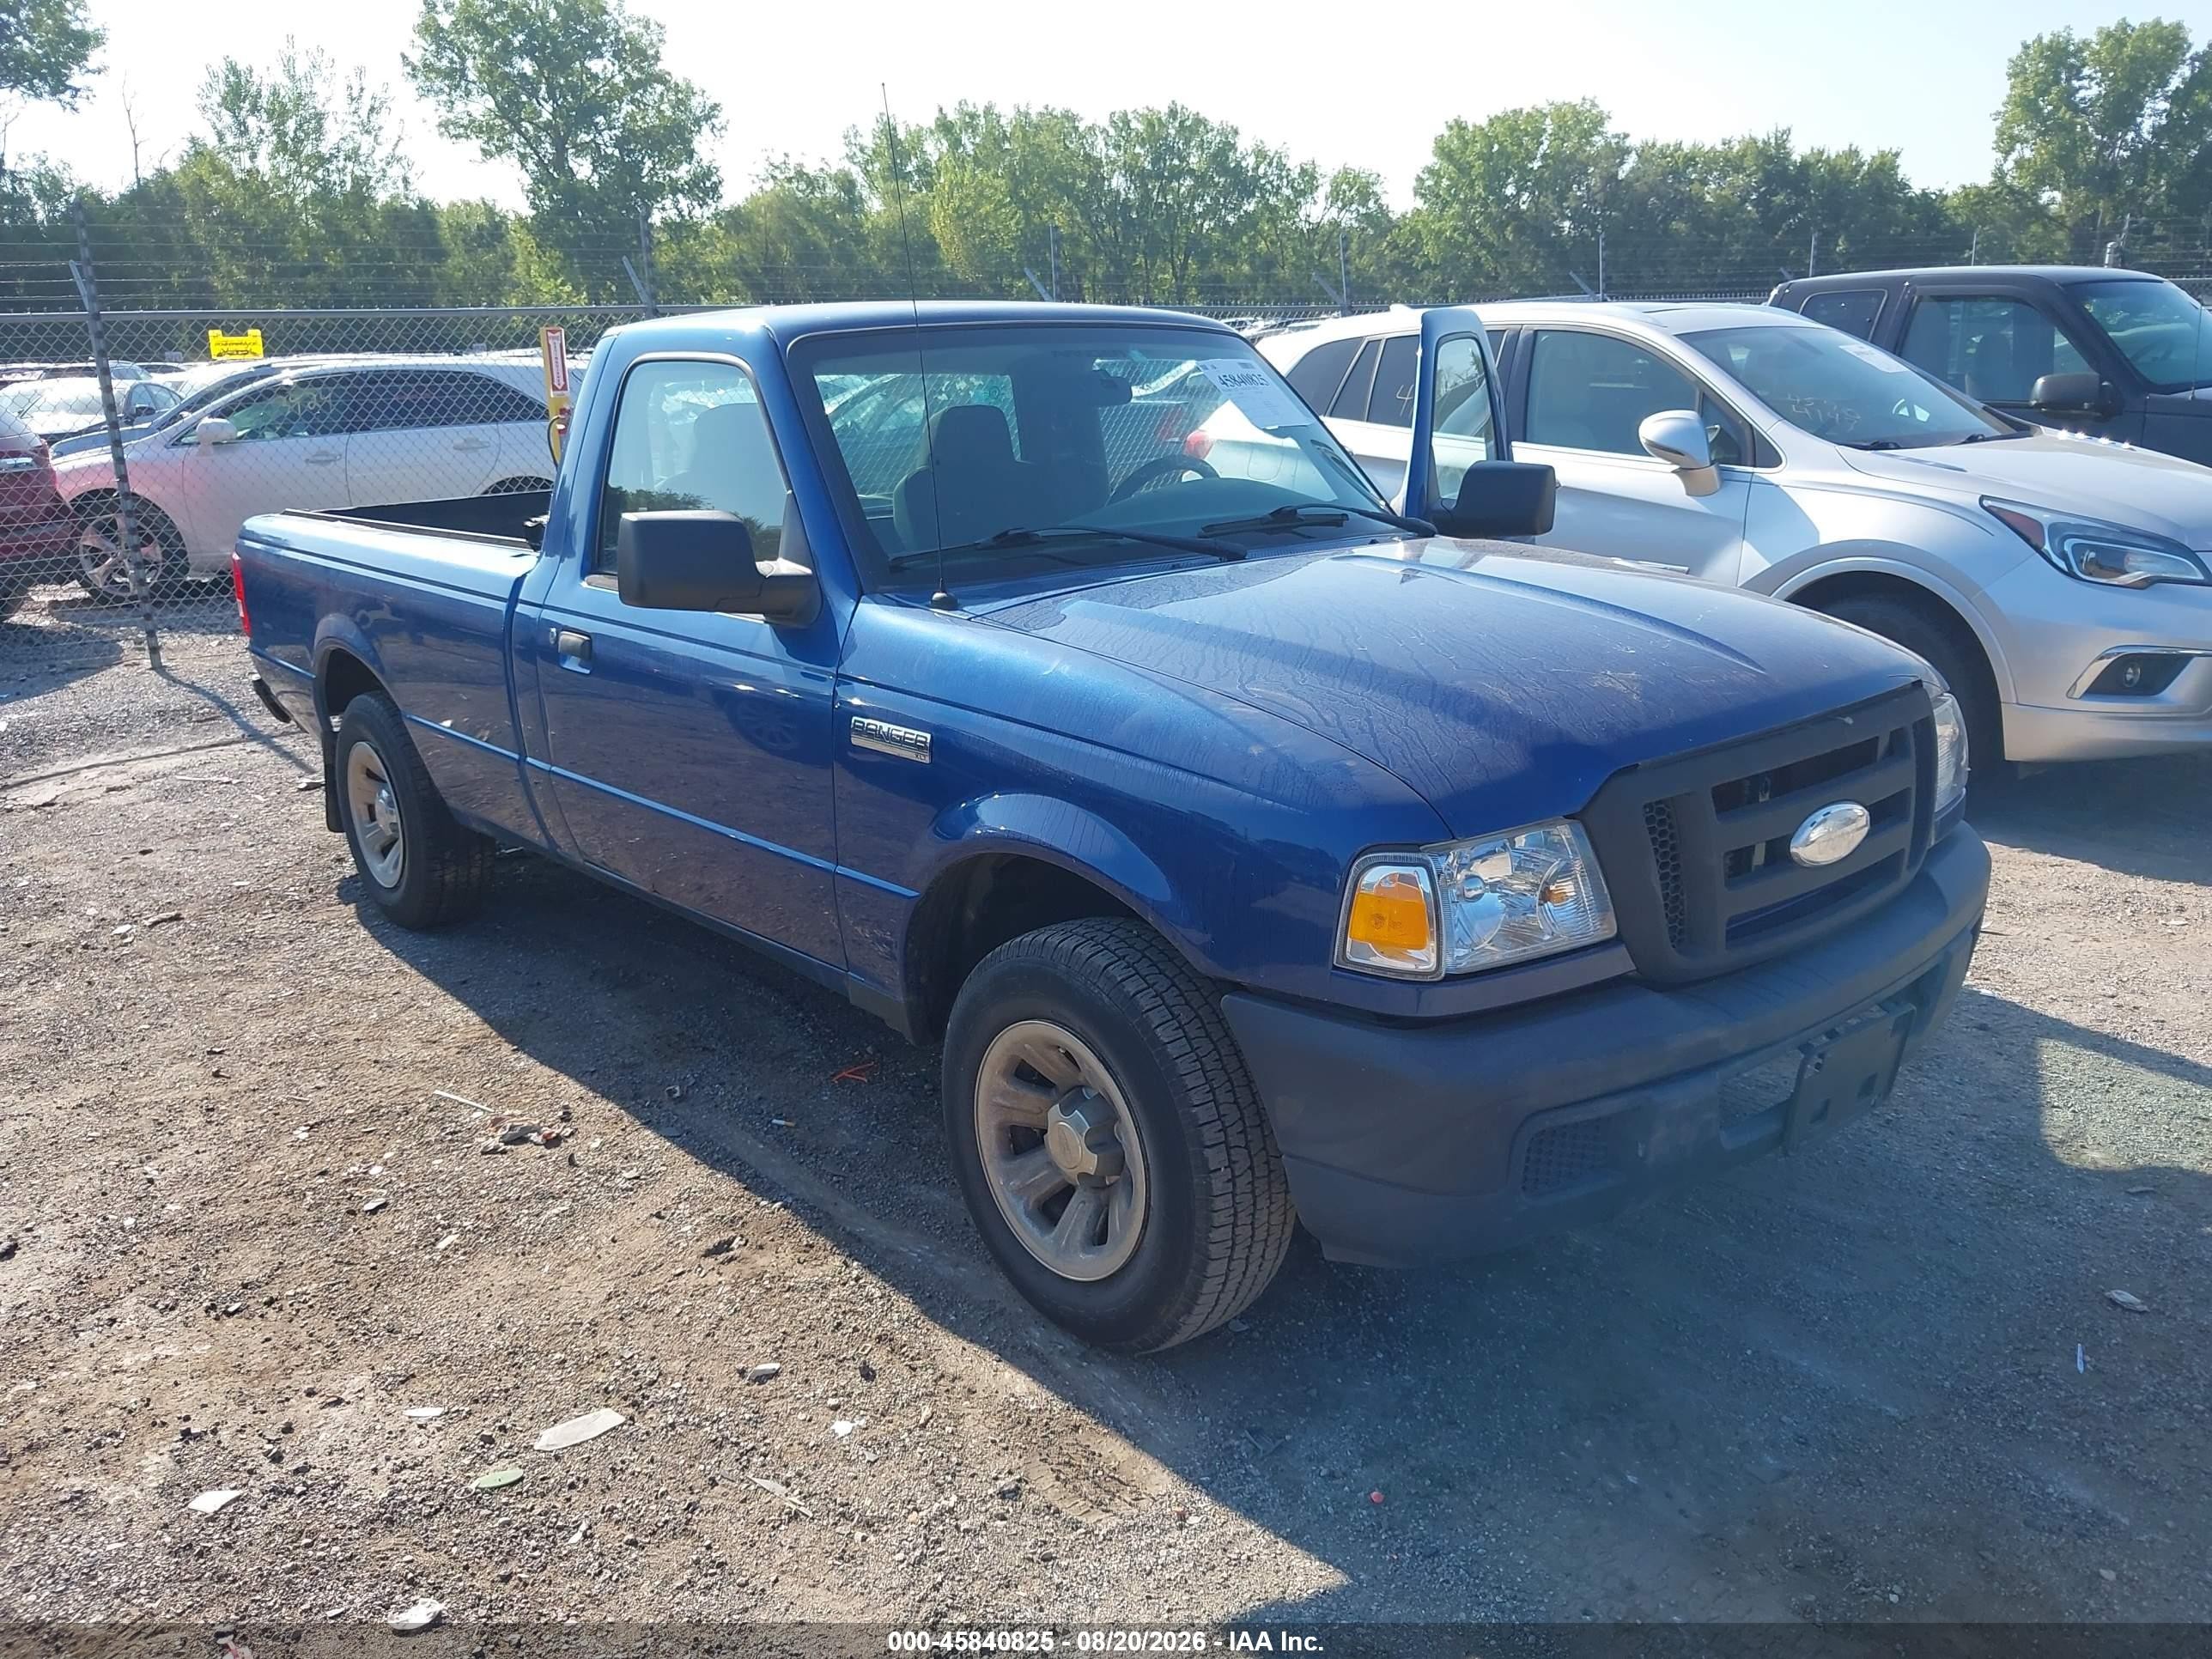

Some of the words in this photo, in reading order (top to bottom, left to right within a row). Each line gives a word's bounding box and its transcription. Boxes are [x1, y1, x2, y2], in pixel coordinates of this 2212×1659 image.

[1218, 374, 1271, 387] 45840825
[1395, 384, 1415, 417] 4
[853, 718, 928, 750] RANGER
